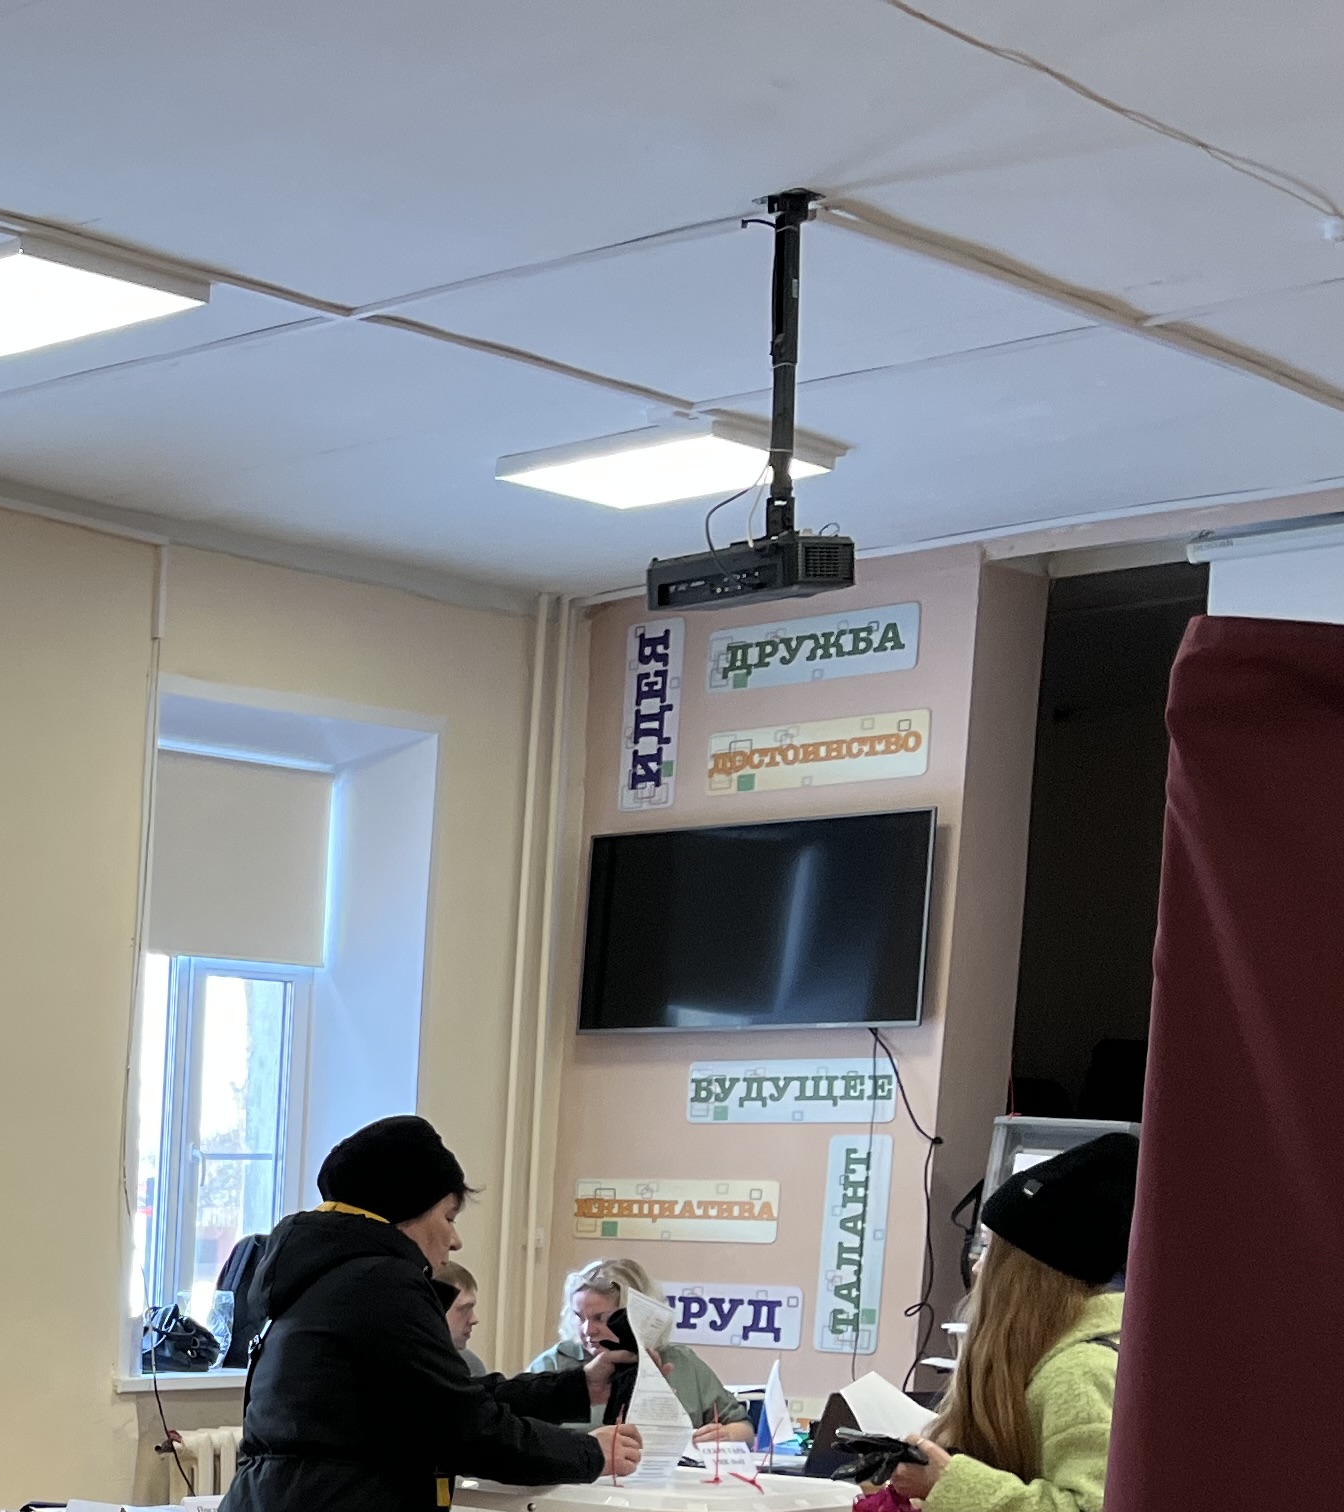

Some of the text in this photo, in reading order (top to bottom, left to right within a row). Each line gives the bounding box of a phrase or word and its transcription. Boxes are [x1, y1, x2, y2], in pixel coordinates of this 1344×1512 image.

[721, 622, 906, 680] ДРУЖБА
[630, 628, 674, 791] ИДЕЯ
[707, 730, 923, 779] ДОСТОИНСТВО
[690, 1074, 894, 1108] БУДУЩЕЕ
[573, 1197, 778, 1224] ИНИЦИАТИВА
[830, 1147, 872, 1335] ТАЛАНТ
[665, 1295, 783, 1343] РУД
